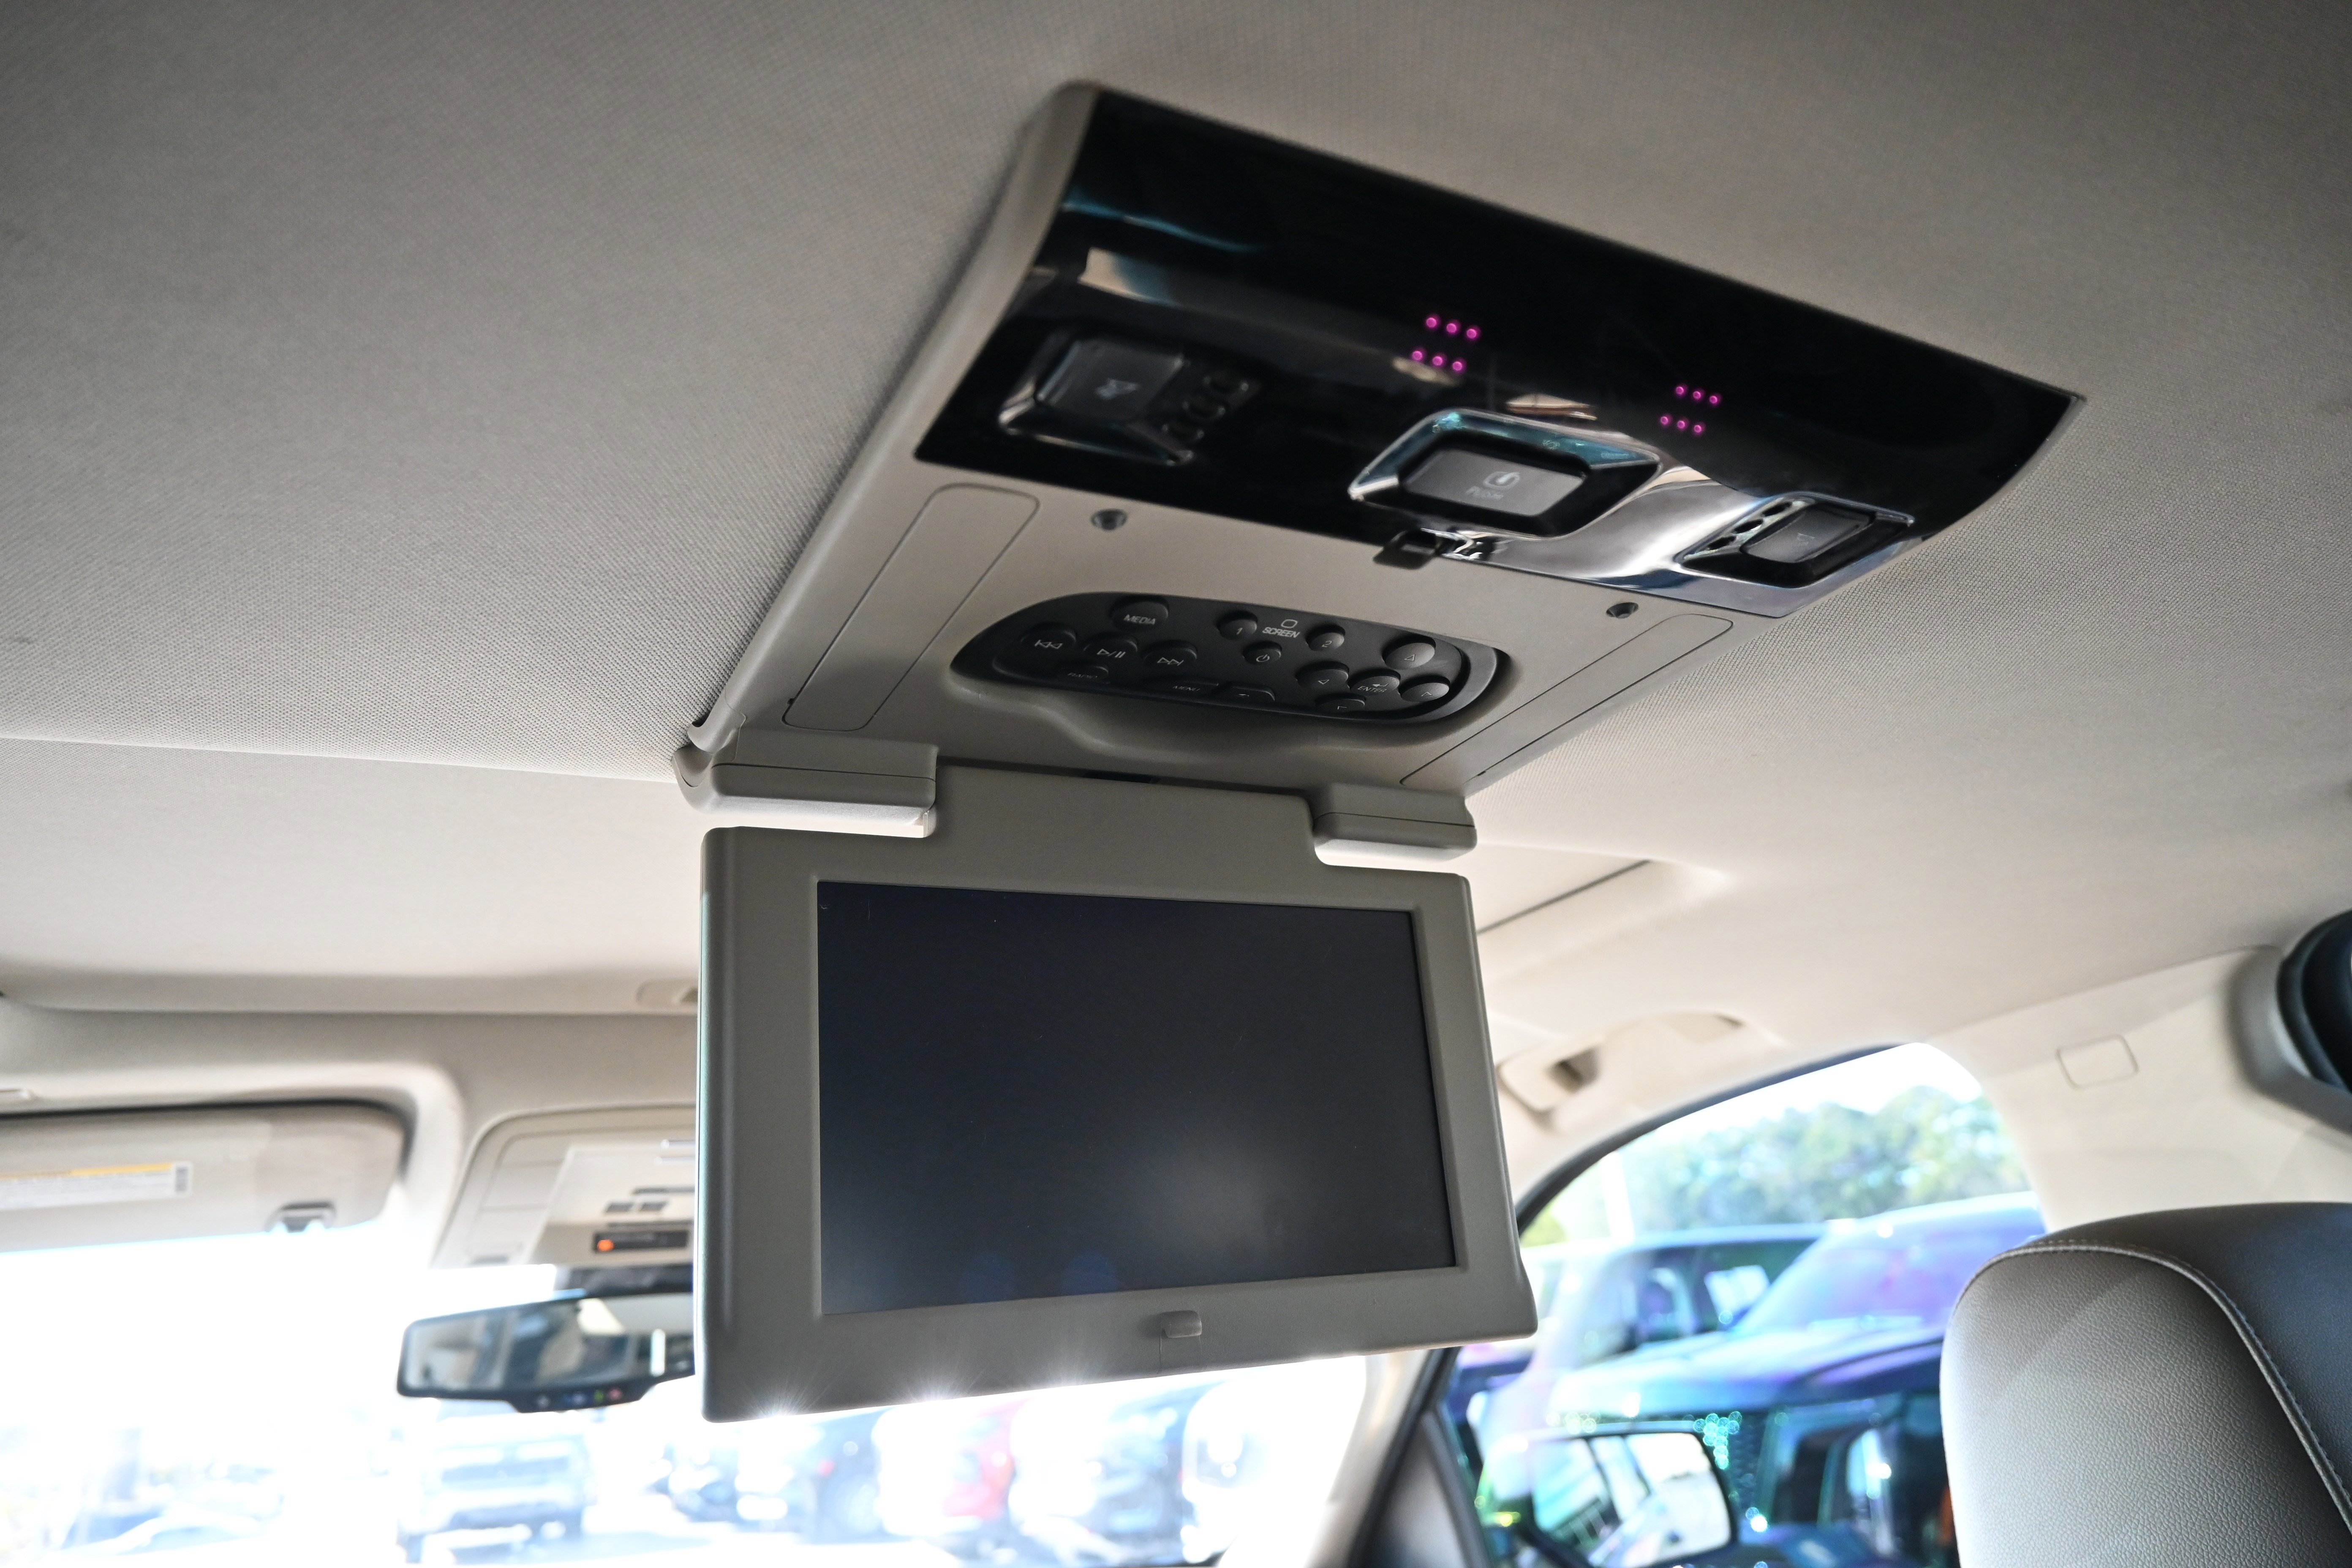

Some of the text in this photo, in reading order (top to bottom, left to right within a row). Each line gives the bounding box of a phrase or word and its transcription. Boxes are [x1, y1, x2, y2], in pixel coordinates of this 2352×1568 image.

[1123, 614, 1156, 625] MEDIA
[1236, 627, 1243, 635] 1
[1262, 626, 1301, 638] SCREEN
